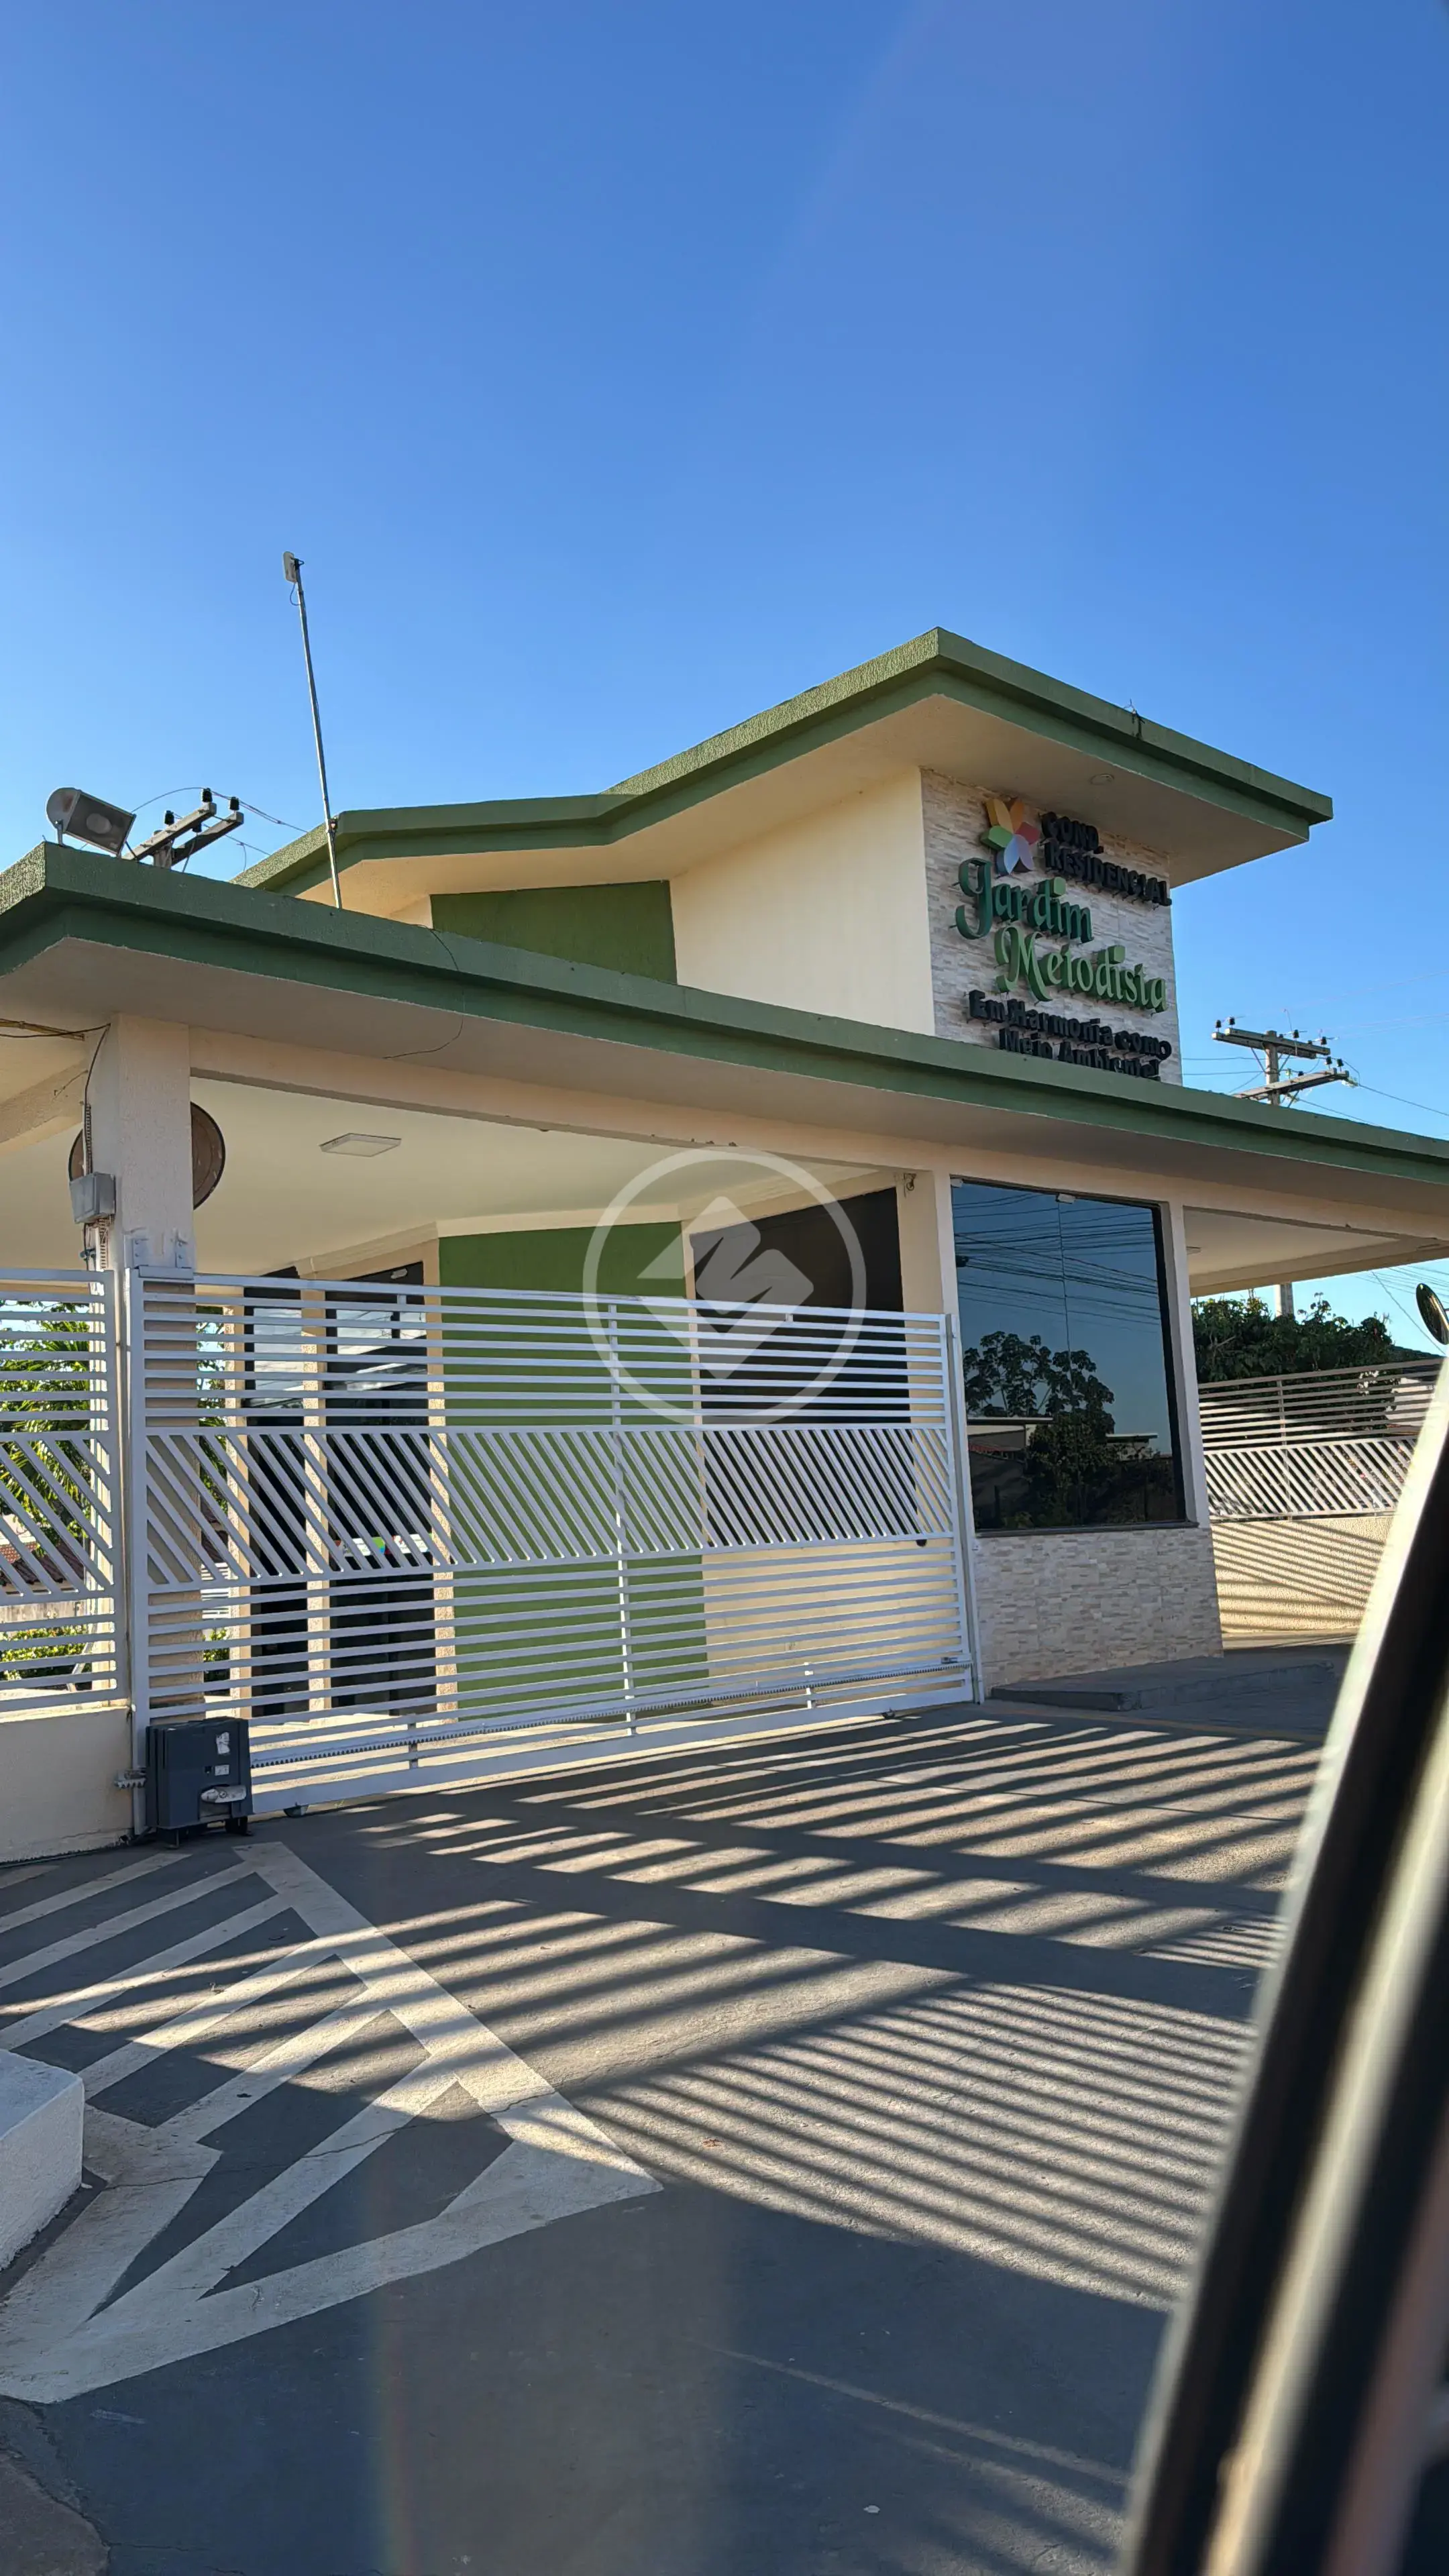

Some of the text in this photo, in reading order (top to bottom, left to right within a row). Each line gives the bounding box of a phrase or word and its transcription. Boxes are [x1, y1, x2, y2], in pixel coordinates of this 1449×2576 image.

[956, 857, 1093, 943] Jardim
[1044, 841, 1172, 906] RESIDENCIAL
[994, 926, 1169, 1013] Metodista
[969, 990, 1005, 1024] Em
[1007, 999, 1112, 1046] Harmonia
